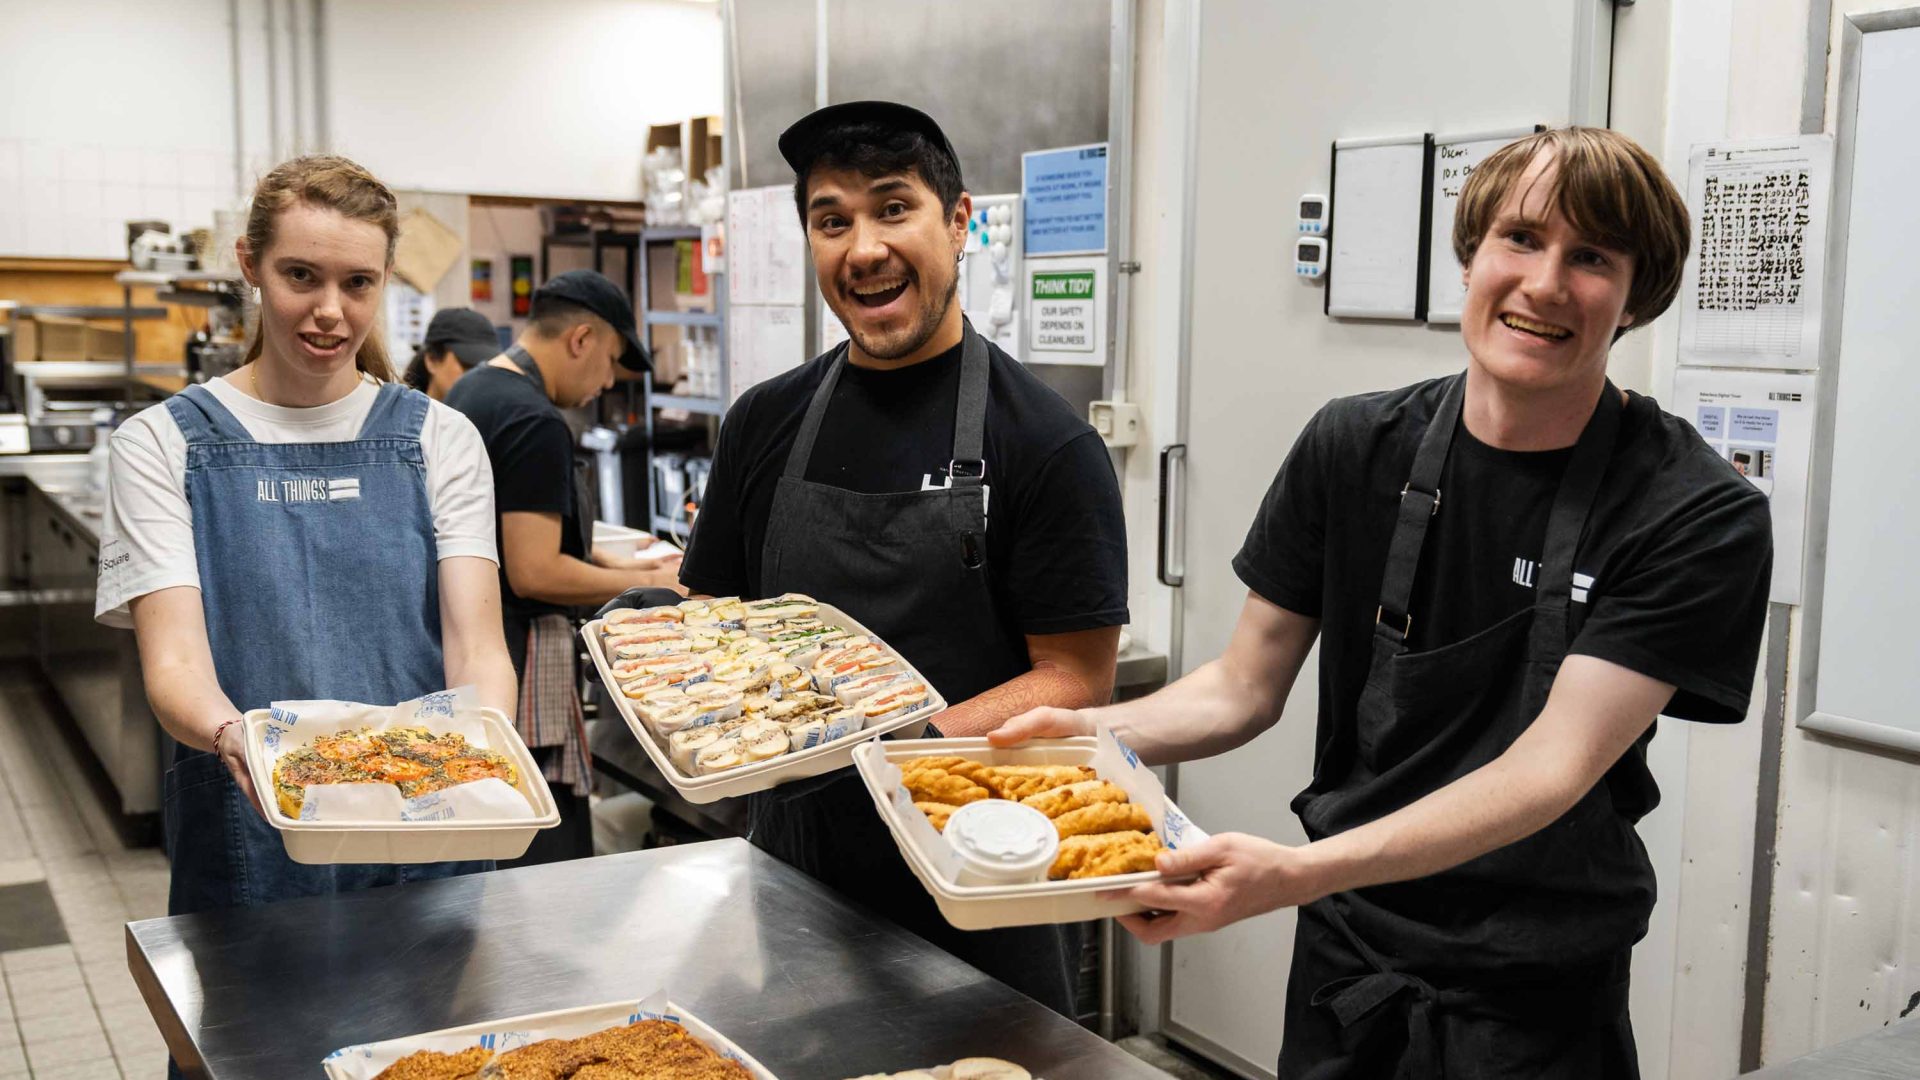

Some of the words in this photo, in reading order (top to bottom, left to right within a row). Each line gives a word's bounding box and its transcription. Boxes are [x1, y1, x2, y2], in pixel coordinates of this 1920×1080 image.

[1035, 279, 1067, 294] THINK
[1068, 278, 1092, 294] TIDY
[1041, 306, 1057, 316] OUR
[1059, 306, 1083, 316] SAFETY
[1040, 320, 1072, 330] DEPENDS
[1073, 321, 1084, 330] ON
[257, 480, 279, 502] ALL
[281, 479, 327, 503] THINGS
[103, 552, 130, 571] Square
[1512, 557, 1534, 588] ALL
